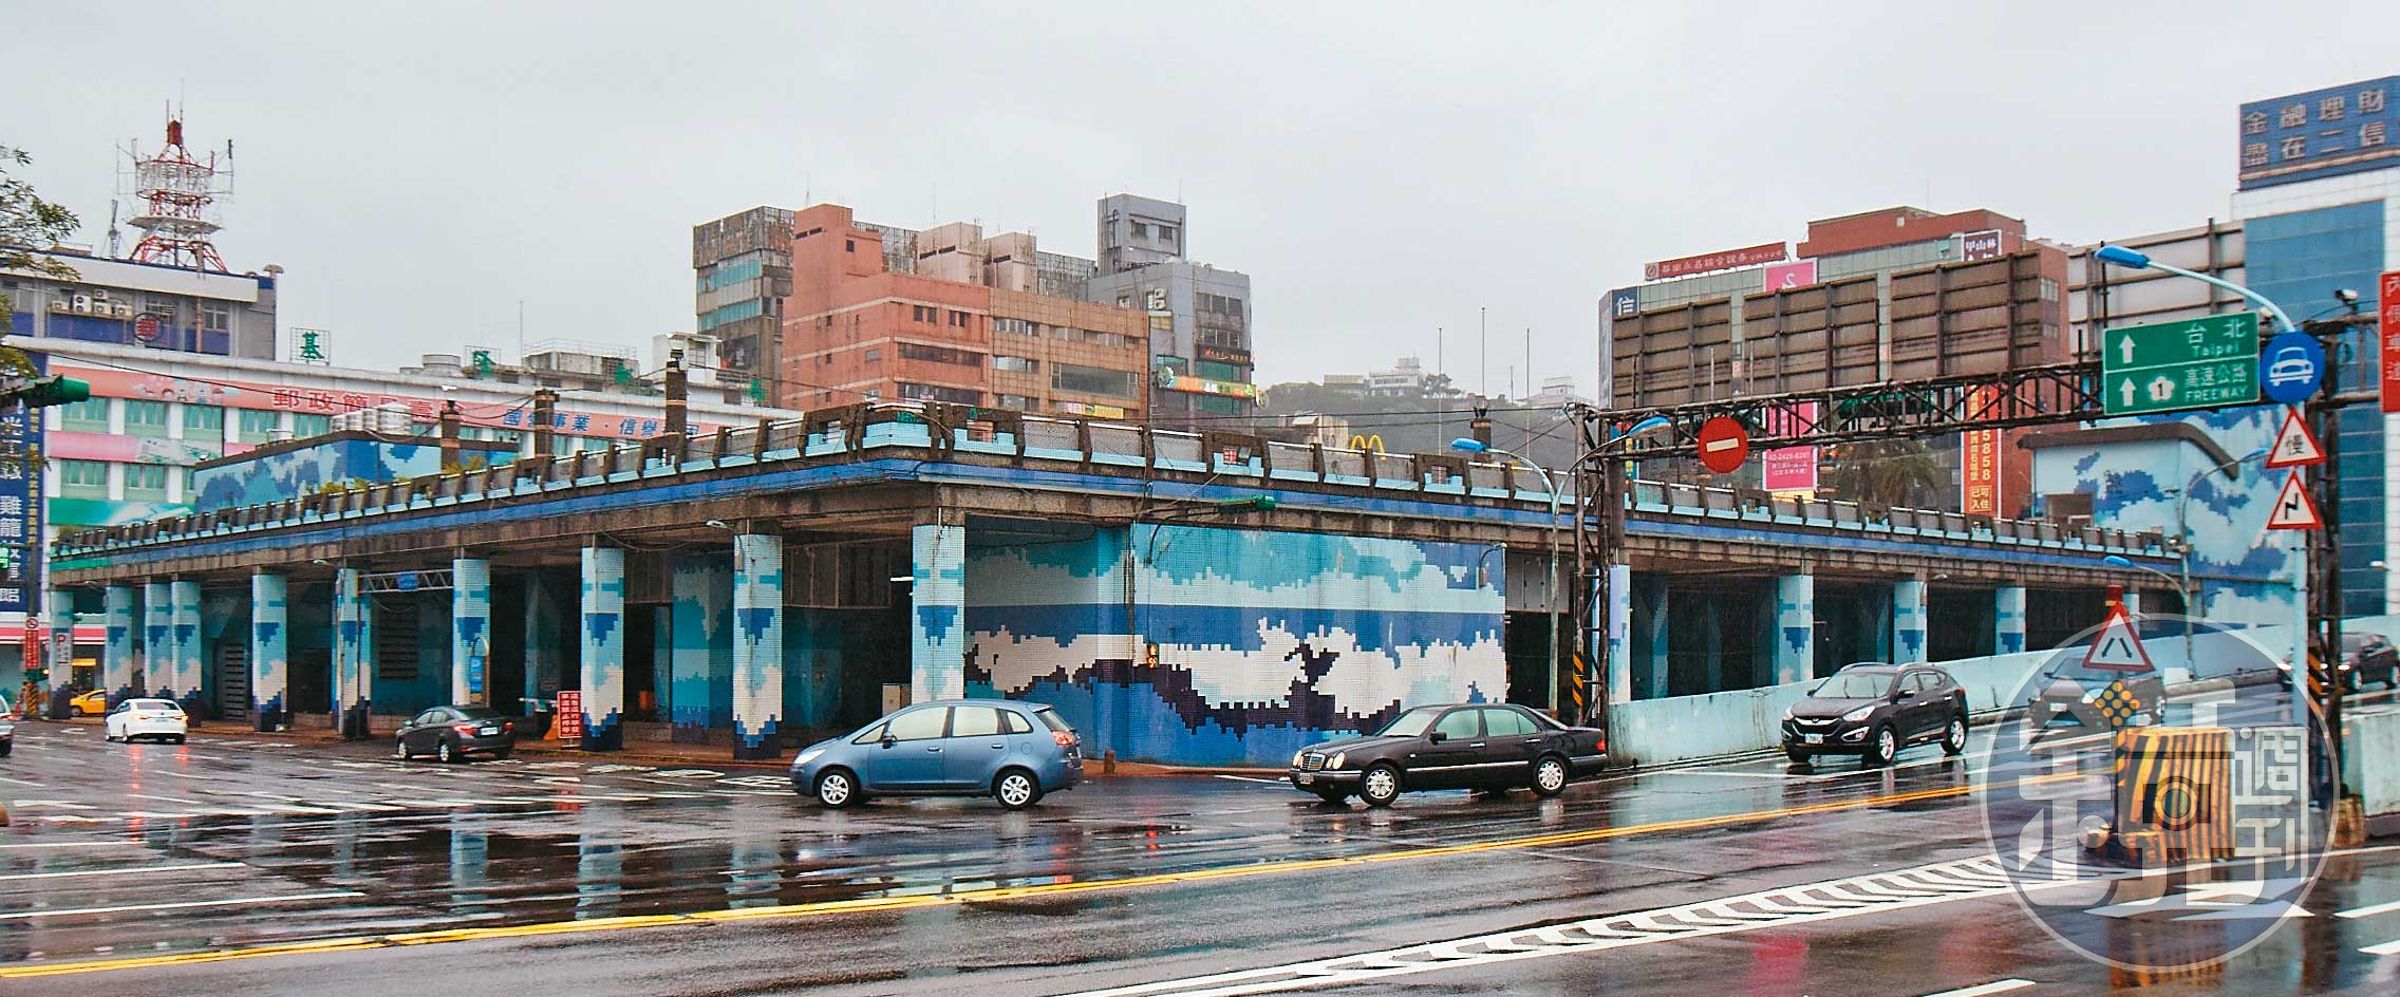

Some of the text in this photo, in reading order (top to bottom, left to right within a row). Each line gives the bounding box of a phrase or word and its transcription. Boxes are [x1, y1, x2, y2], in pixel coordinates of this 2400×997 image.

[2245, 88, 2385, 136] 金融理財
[2245, 121, 2386, 167] 盡在二信
[1616, 296, 1634, 316] 信
[2184, 318, 2247, 345] 台北
[300, 331, 325, 359] 基
[2191, 343, 2240, 358] Taipei
[2184, 363, 2248, 386] 高速公路
[2157, 383, 2163, 397] 1
[2185, 386, 2248, 402] FREEWAY
[2286, 434, 2304, 455] 慢
